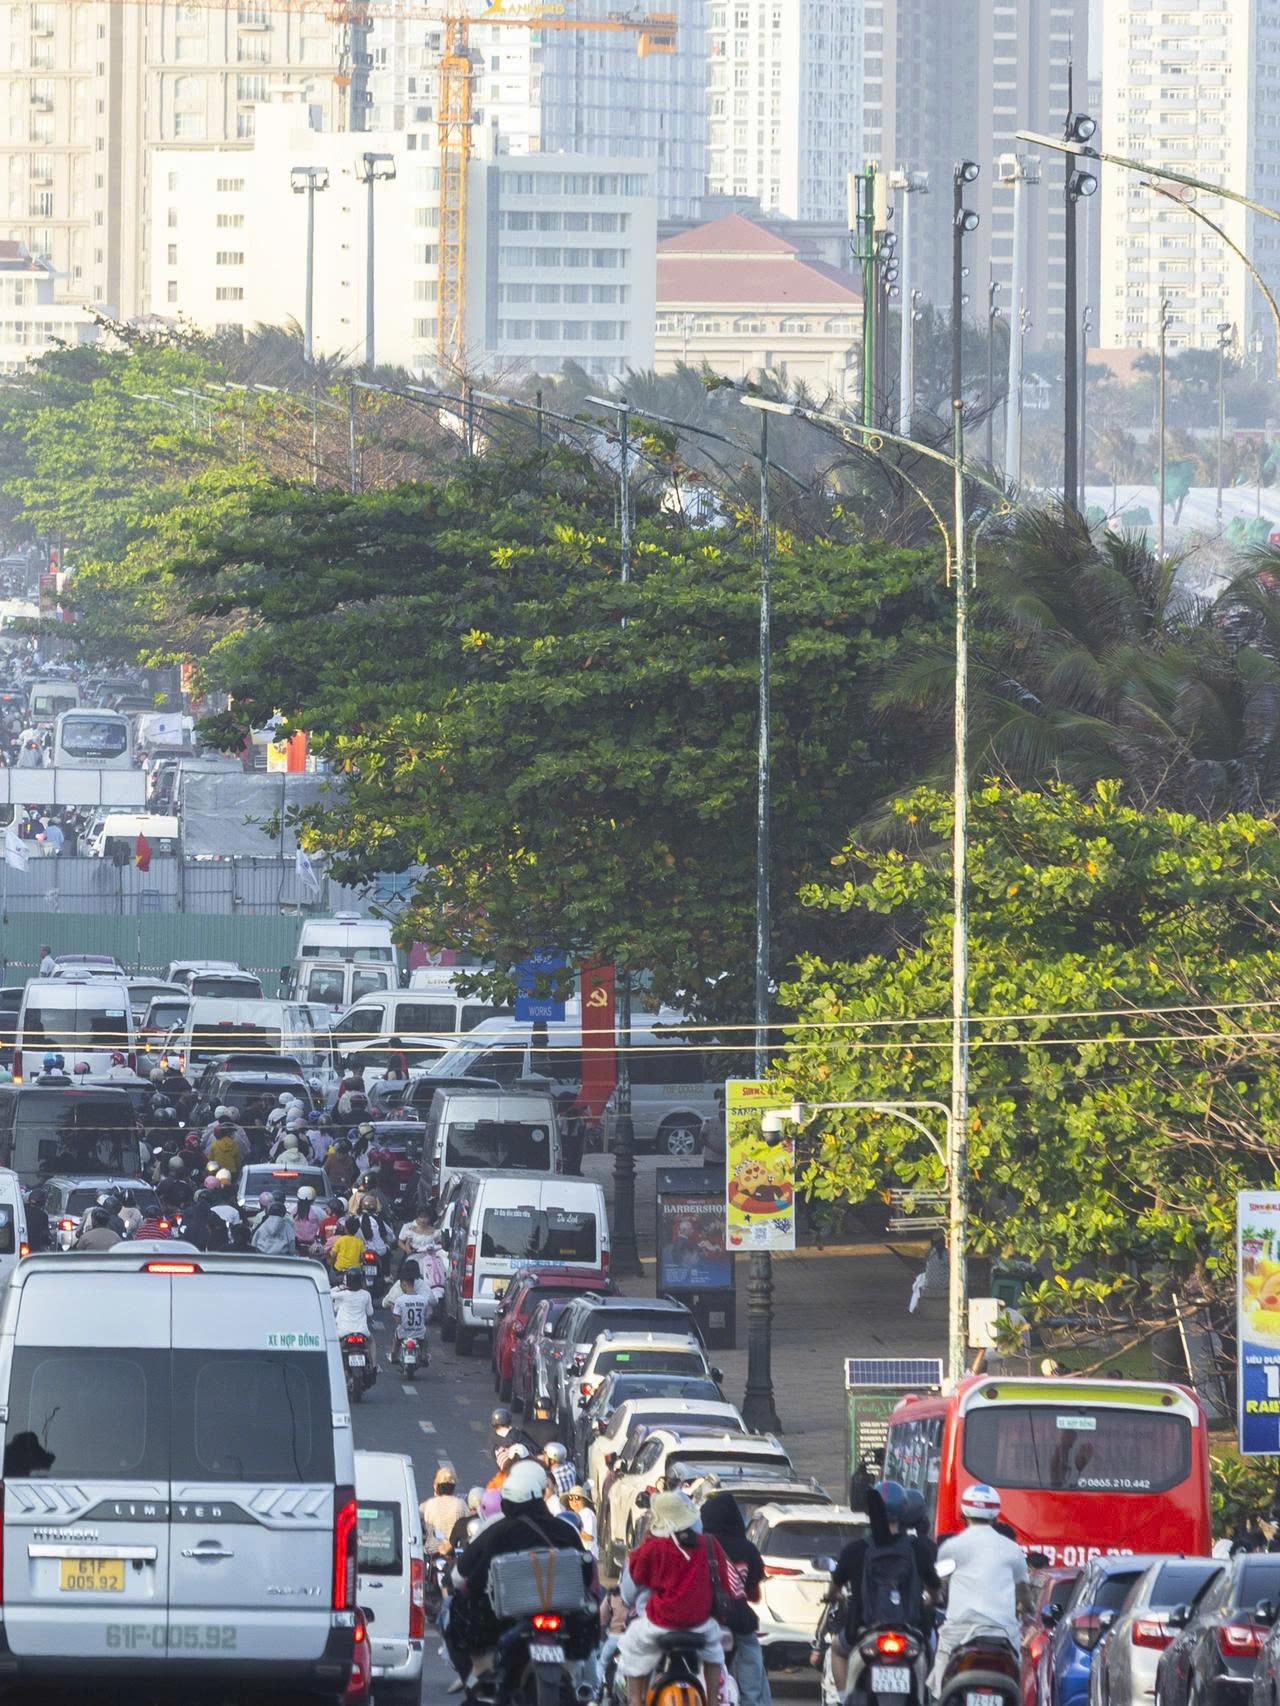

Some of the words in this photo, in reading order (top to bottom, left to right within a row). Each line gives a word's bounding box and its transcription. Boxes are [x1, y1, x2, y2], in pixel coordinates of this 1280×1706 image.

[528, 1006, 552, 1017] WORKS
[407, 1308, 423, 1327] 93
[267, 1334, 278, 1346] XE
[114, 1505, 222, 1517] LIMITED
[32, 1527, 99, 1541] HYUNDAI
[78, 1559, 106, 1575] 61F
[66, 1575, 118, 1590] 005.92
